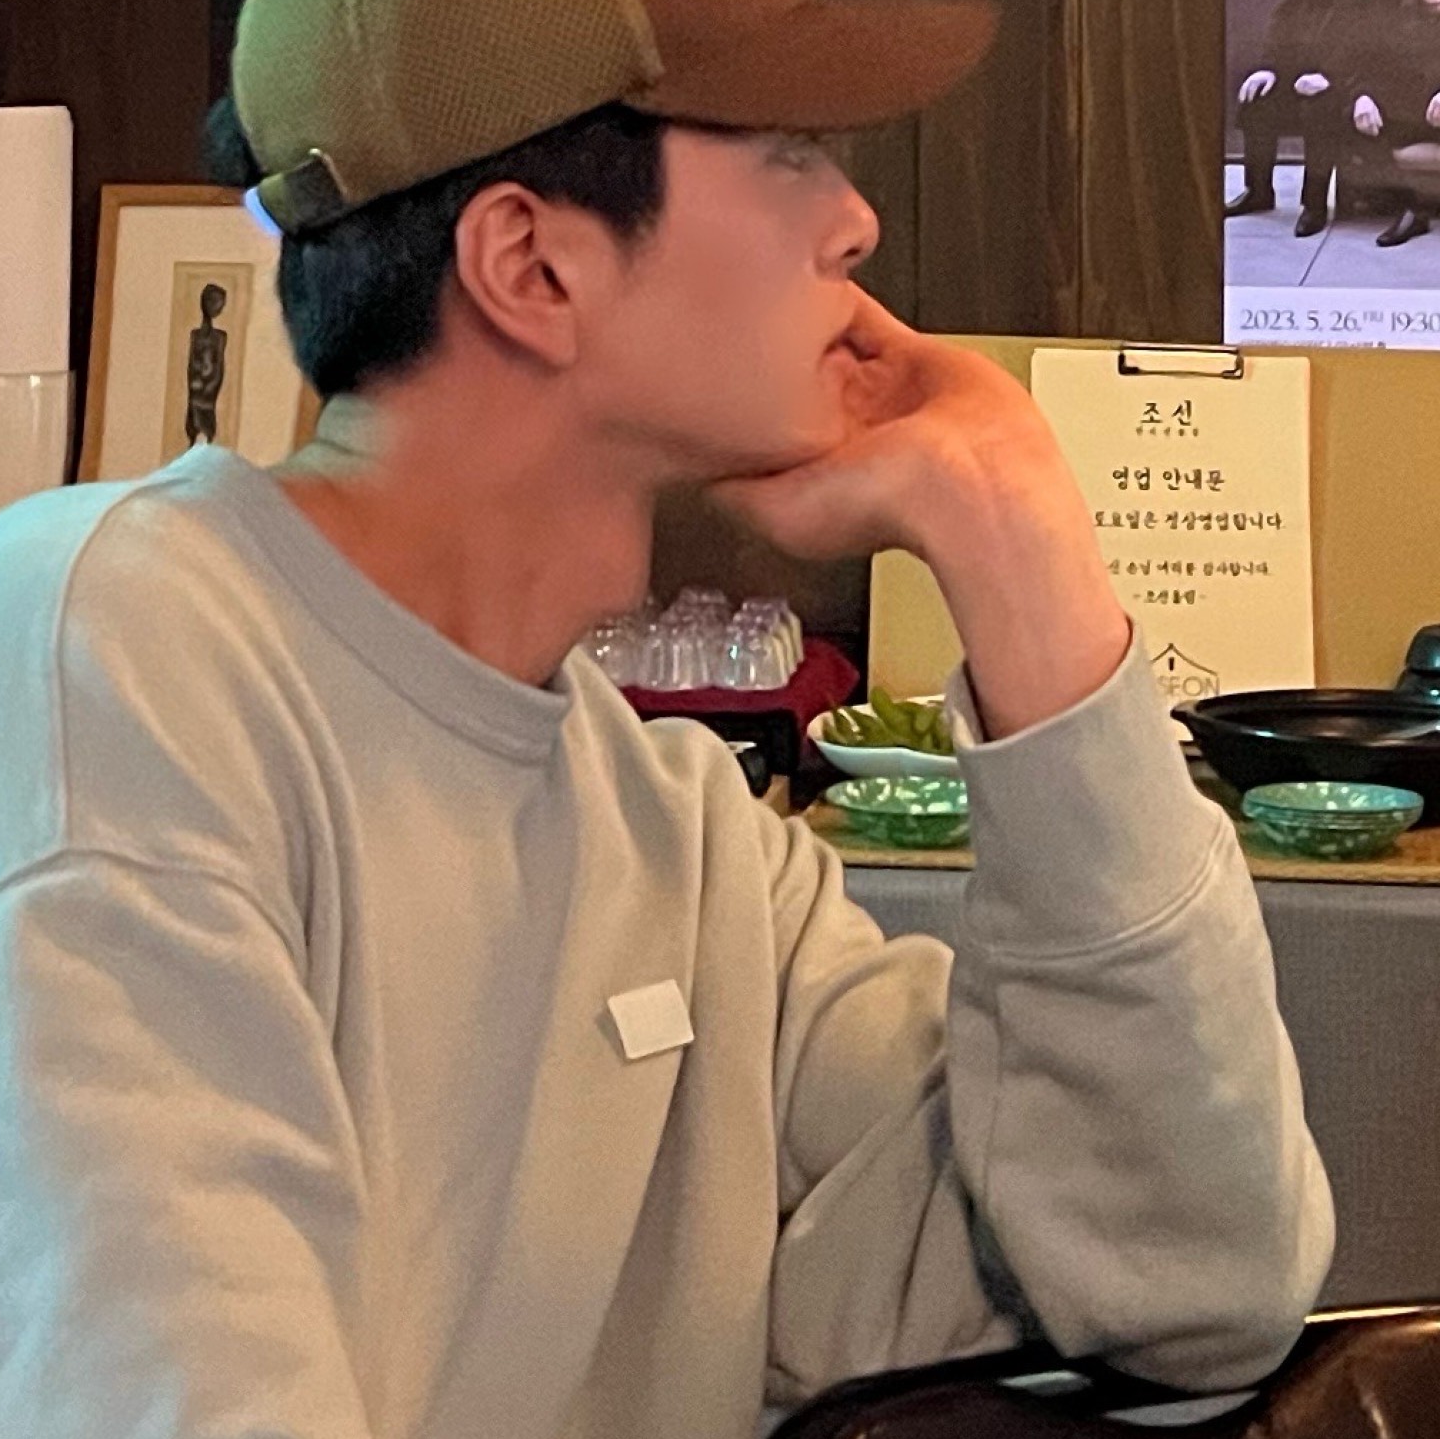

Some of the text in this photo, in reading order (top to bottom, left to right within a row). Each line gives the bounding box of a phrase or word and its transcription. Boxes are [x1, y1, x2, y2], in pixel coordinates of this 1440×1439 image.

[1240, 308, 1300, 332] 2023.
[1111, 466, 1225, 493] 영업 안내문
